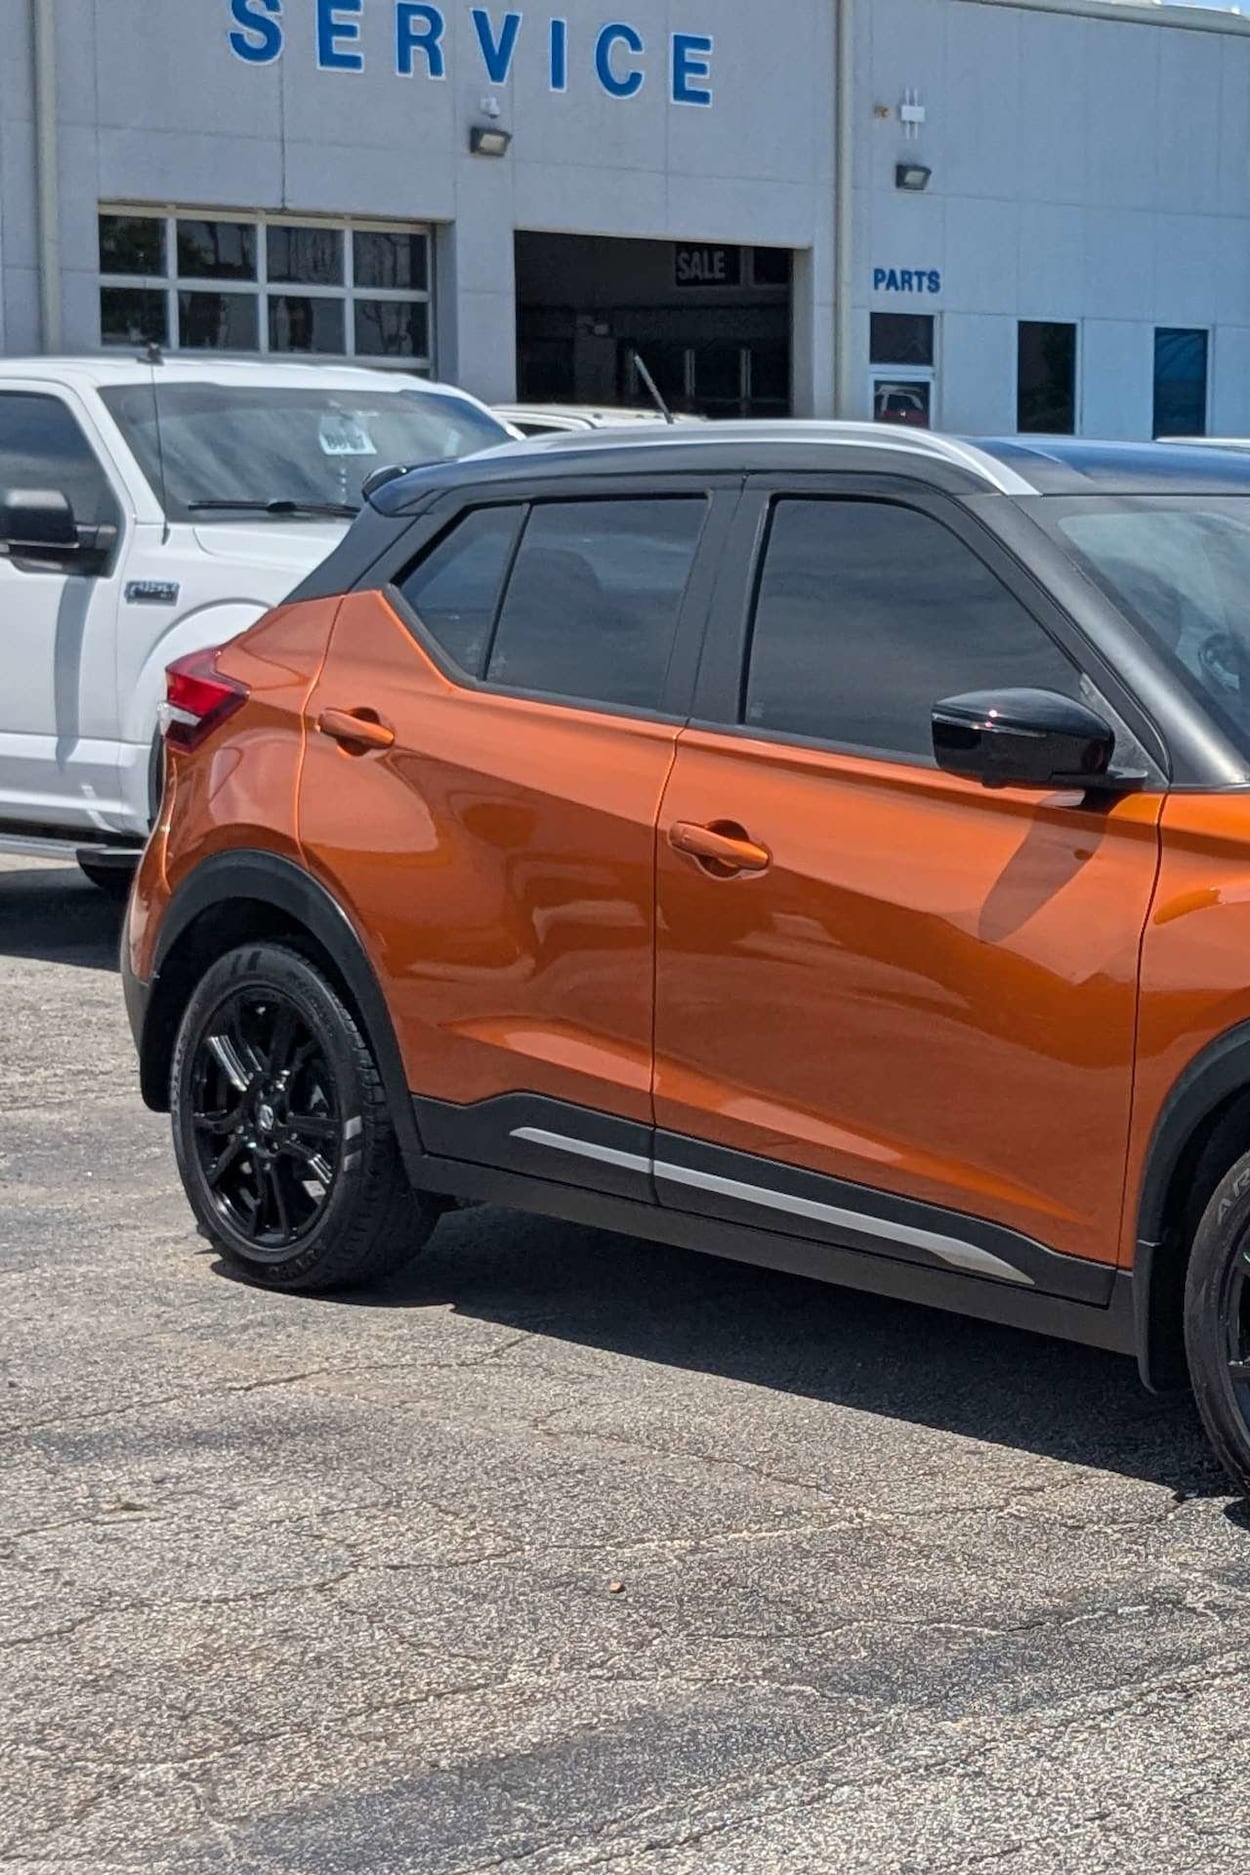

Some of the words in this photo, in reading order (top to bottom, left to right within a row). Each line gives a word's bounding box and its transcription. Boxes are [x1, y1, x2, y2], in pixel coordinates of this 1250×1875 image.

[229, 0, 713, 107] SERVICE
[678, 250, 725, 280] SALE
[873, 267, 941, 294] PARTS
